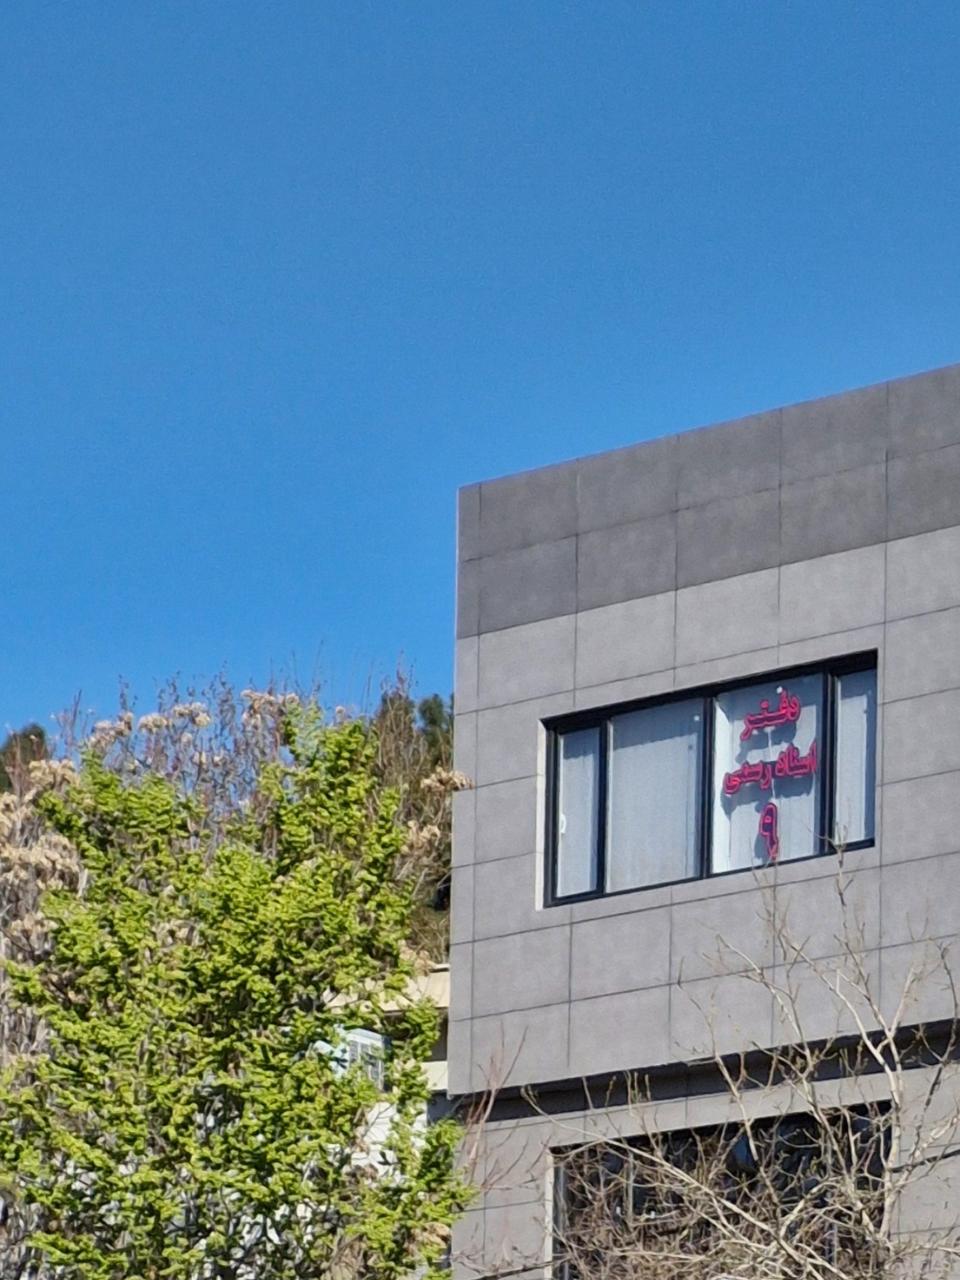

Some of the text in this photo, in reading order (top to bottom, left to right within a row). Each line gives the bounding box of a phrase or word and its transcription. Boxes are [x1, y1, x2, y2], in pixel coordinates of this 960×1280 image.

[740, 688, 800, 741] دفتر
[722, 741, 817, 794] اسناد رسمی
